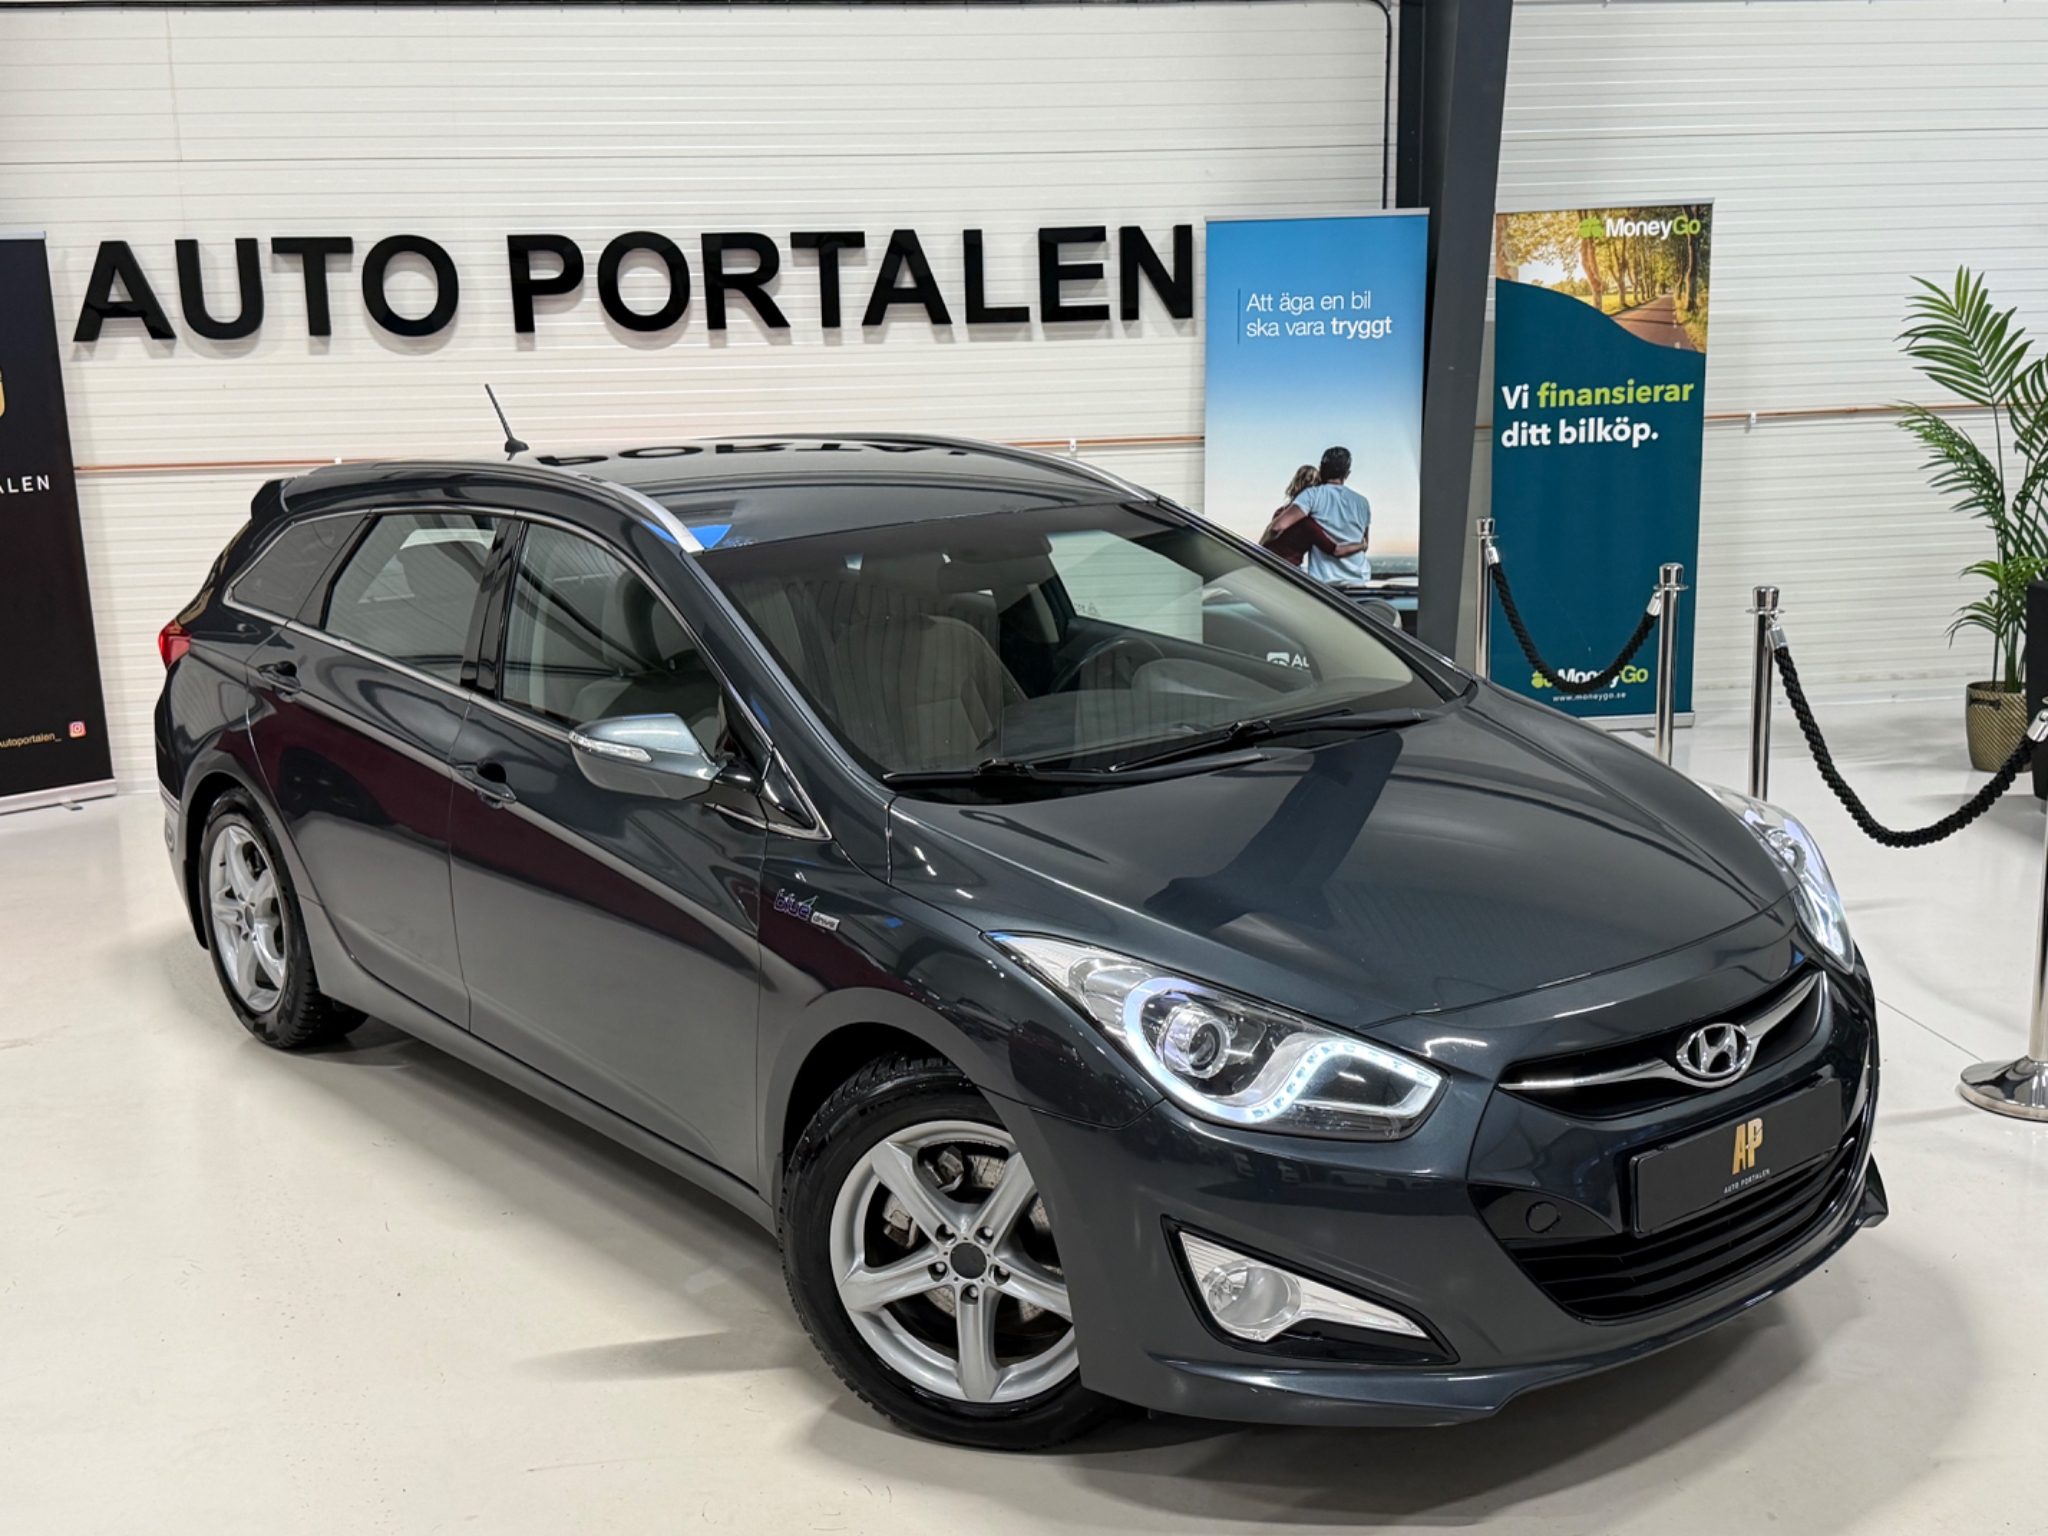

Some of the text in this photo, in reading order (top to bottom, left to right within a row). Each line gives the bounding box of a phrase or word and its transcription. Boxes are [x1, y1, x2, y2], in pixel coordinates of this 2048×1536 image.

[1605, 215, 1701, 240] MoneyGo
[74, 224, 1194, 342] AUTO PORTALEN
[1246, 290, 1371, 316] Att äga en bil
[1246, 316, 1393, 339] ska vara tryggt
[1501, 378, 1695, 410] Vi finansierar
[1501, 416, 1659, 449] ditt bilköp.
[1552, 692, 1627, 702] www.moneygo.se
[1732, 1117, 1763, 1175] AP
[1724, 1168, 1770, 1194] AUTO PORTALEN
